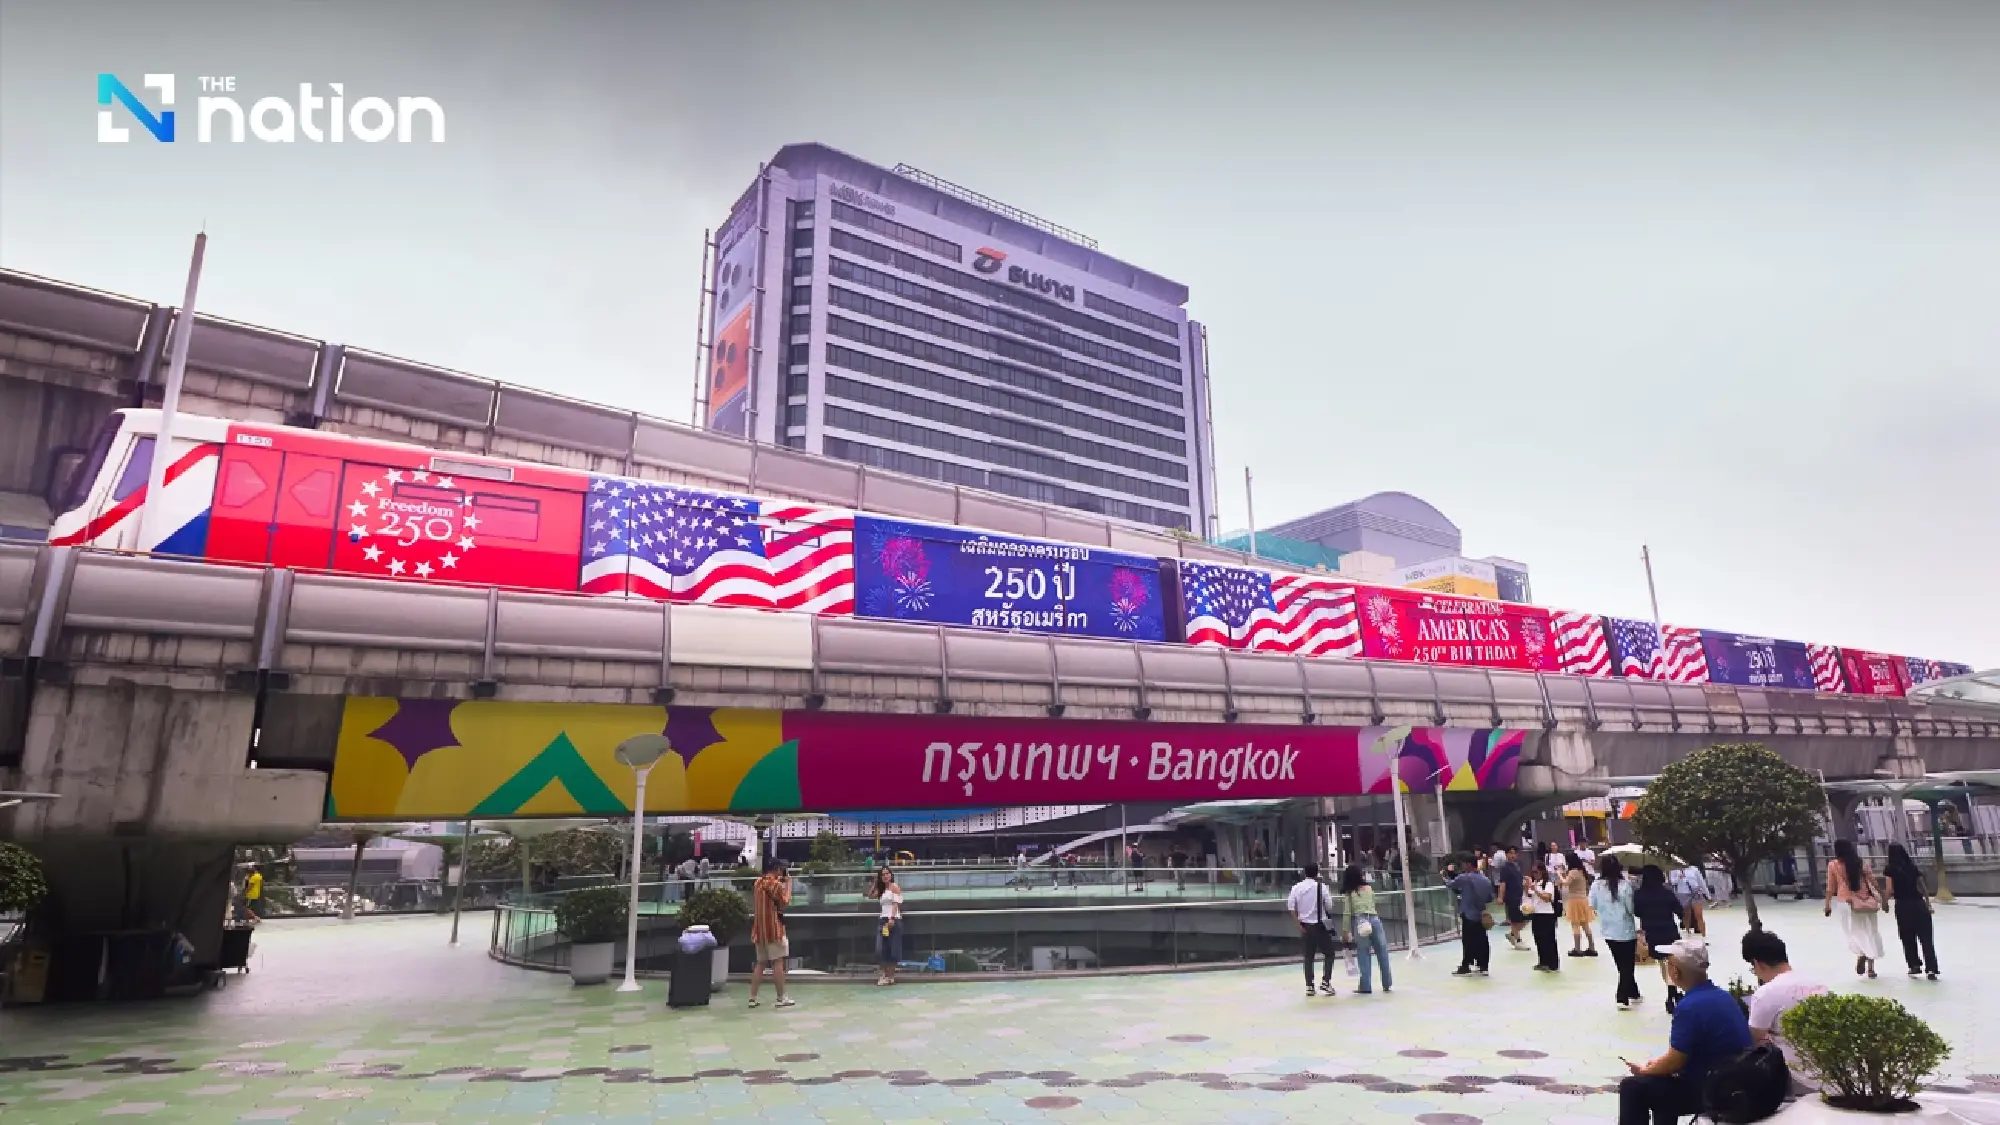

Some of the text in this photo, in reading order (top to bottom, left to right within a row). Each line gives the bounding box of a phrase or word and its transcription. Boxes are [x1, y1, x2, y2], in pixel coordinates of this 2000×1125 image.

[378, 497, 455, 518] Freedom
[375, 511, 453, 547] 250
[984, 561, 1076, 601] 250 ปี
[971, 601, 1089, 634] สหรัฐอเมริกา
[1417, 618, 1511, 641] AMERICA'S
[1449, 645, 1518, 661] BIRTHDAY
[921, 742, 1300, 797] กรุงเทพฯ Bangkok
